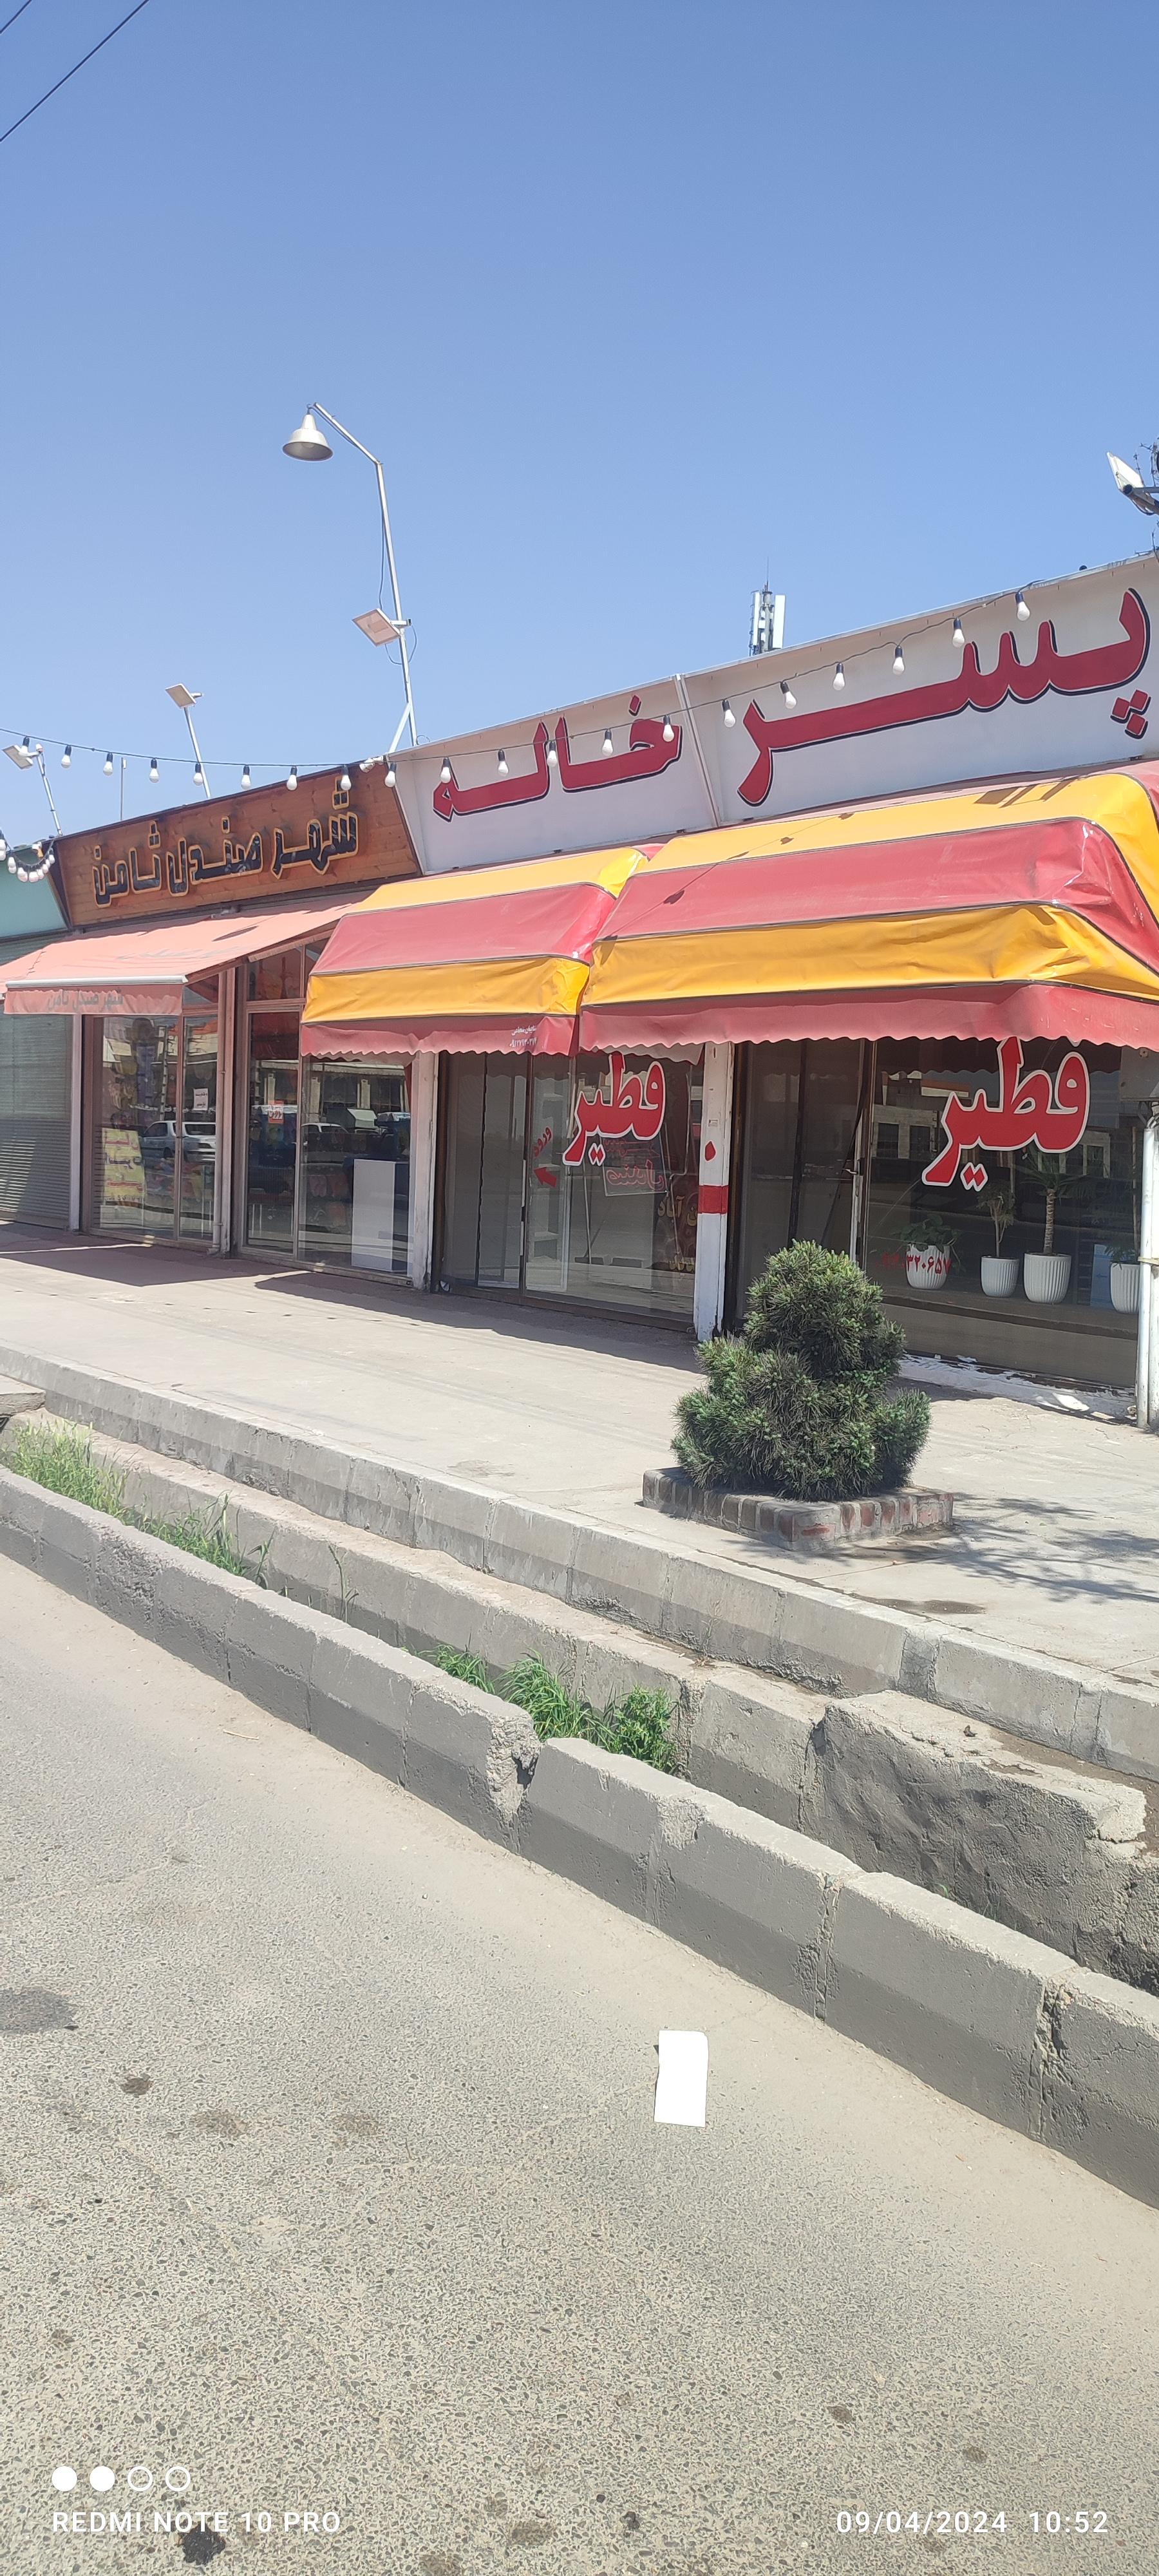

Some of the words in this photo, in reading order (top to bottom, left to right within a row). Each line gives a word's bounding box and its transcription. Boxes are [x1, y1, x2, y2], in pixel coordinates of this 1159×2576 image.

[737, 588, 1150, 806] پسر
[433, 695, 683, 822] خاله
[92, 820, 162, 908] ثامن
[167, 815, 263, 896] صندل
[270, 776, 359, 880] شهر
[533, 1127, 552, 1158] ورود
